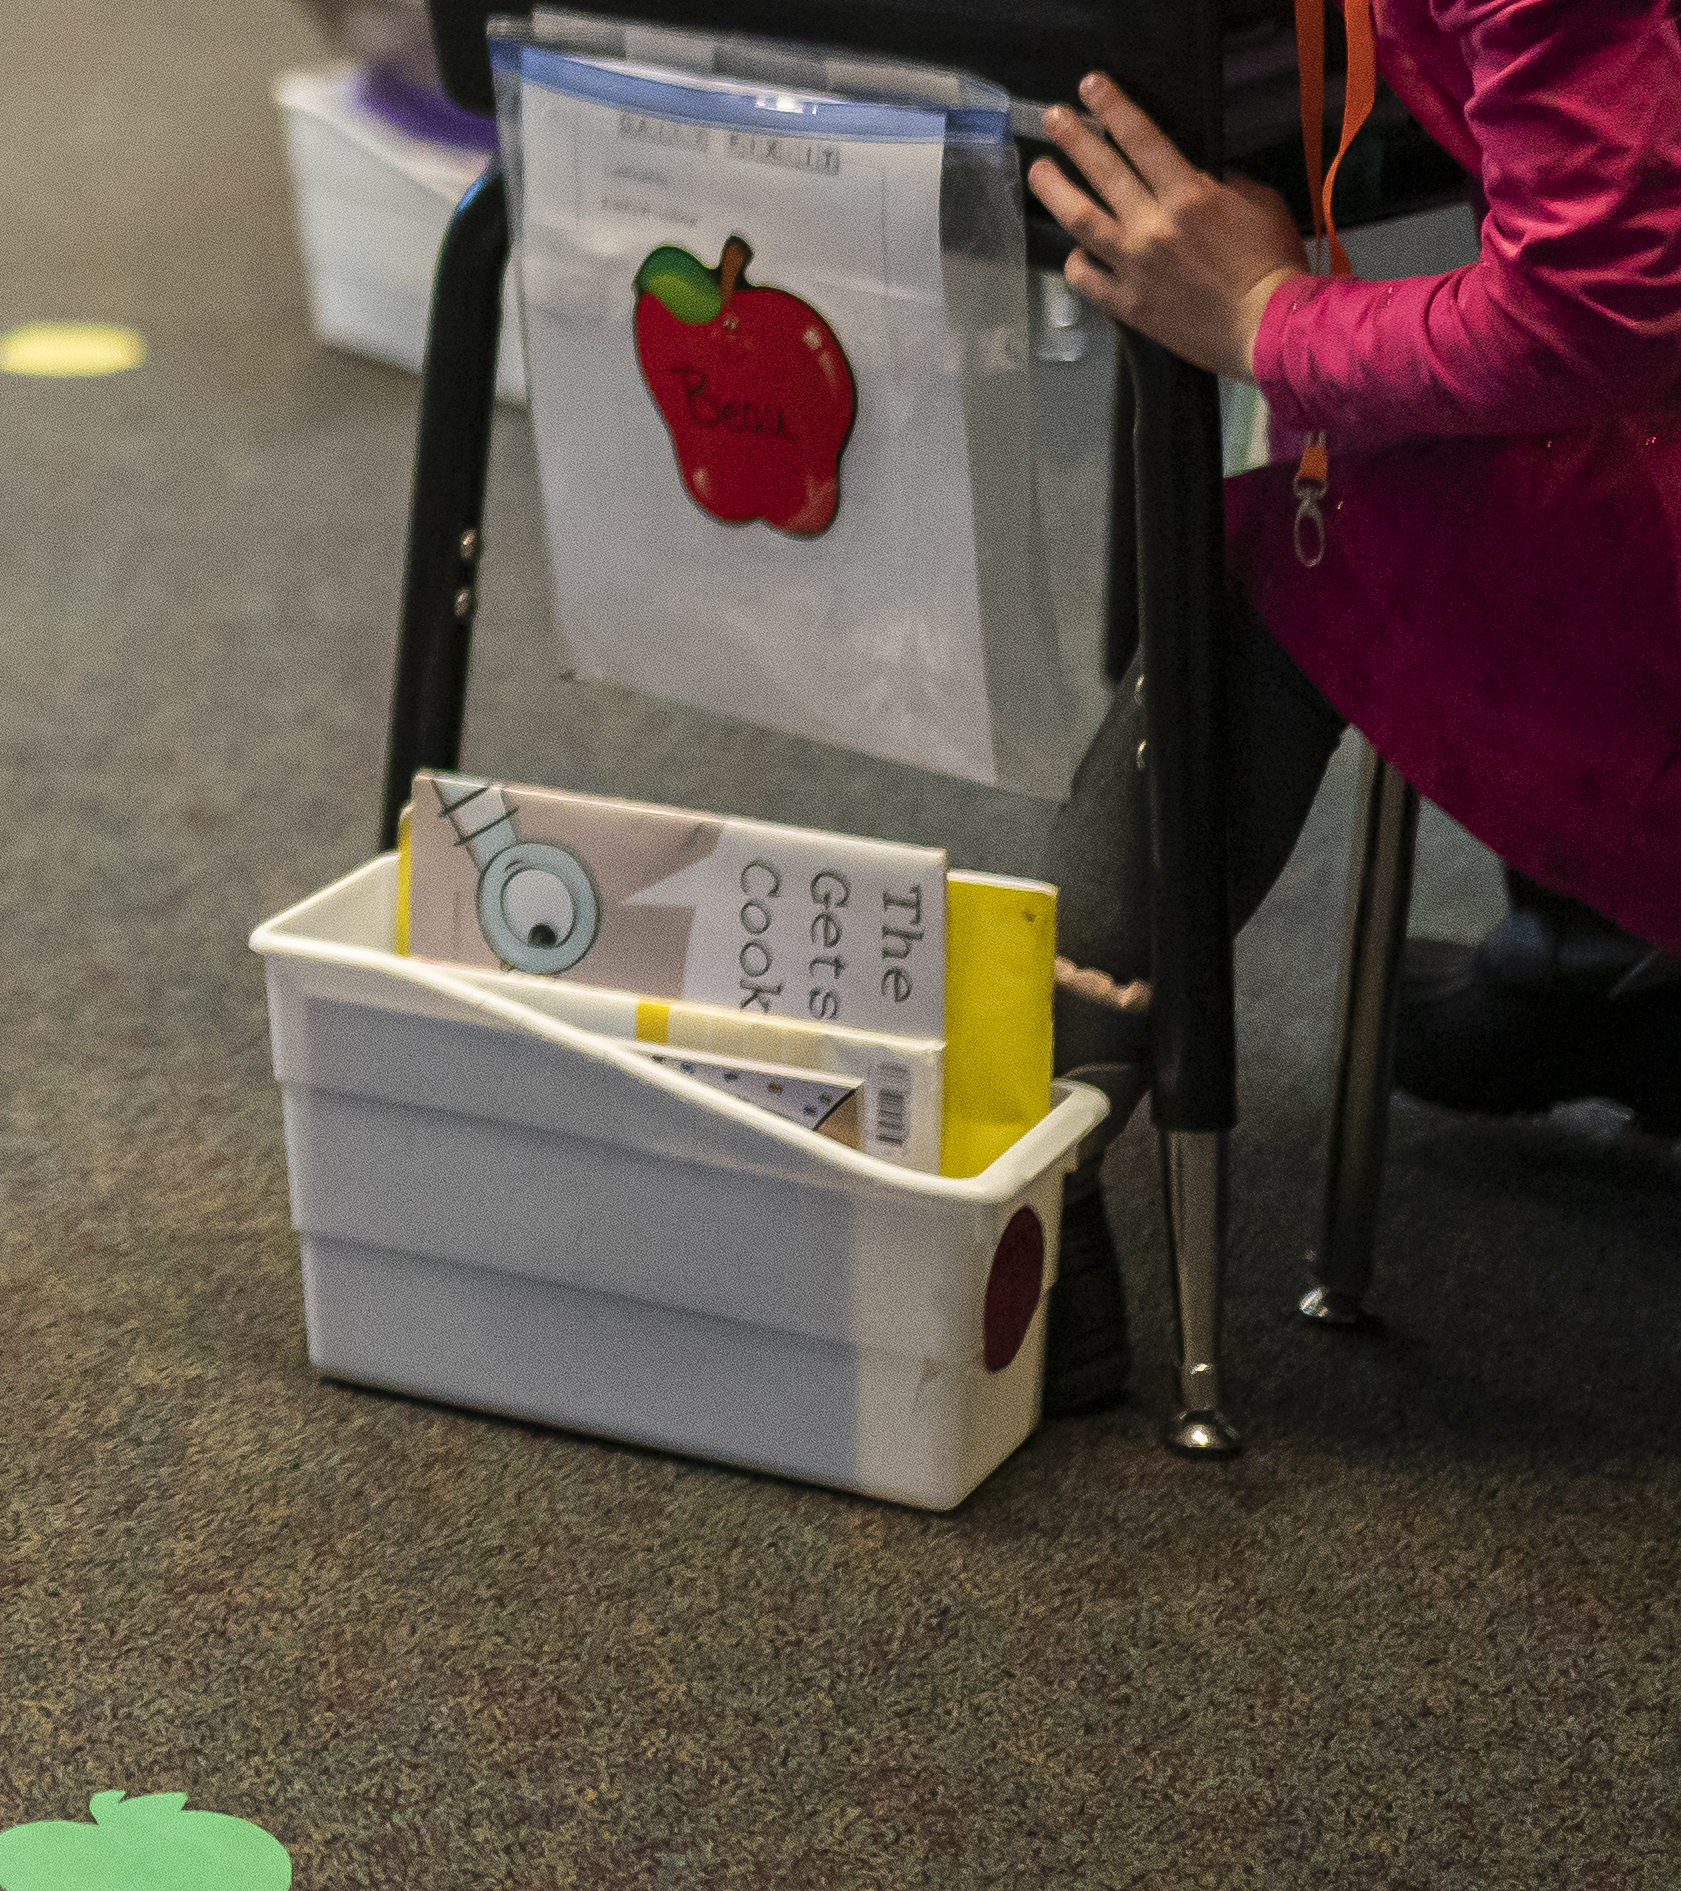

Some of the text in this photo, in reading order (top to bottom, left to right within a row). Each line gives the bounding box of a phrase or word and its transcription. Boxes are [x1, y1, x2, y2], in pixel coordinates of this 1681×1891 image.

[739, 860, 783, 1014] Cook
[808, 870, 852, 1020] Gets
[880, 883, 925, 1004] The
